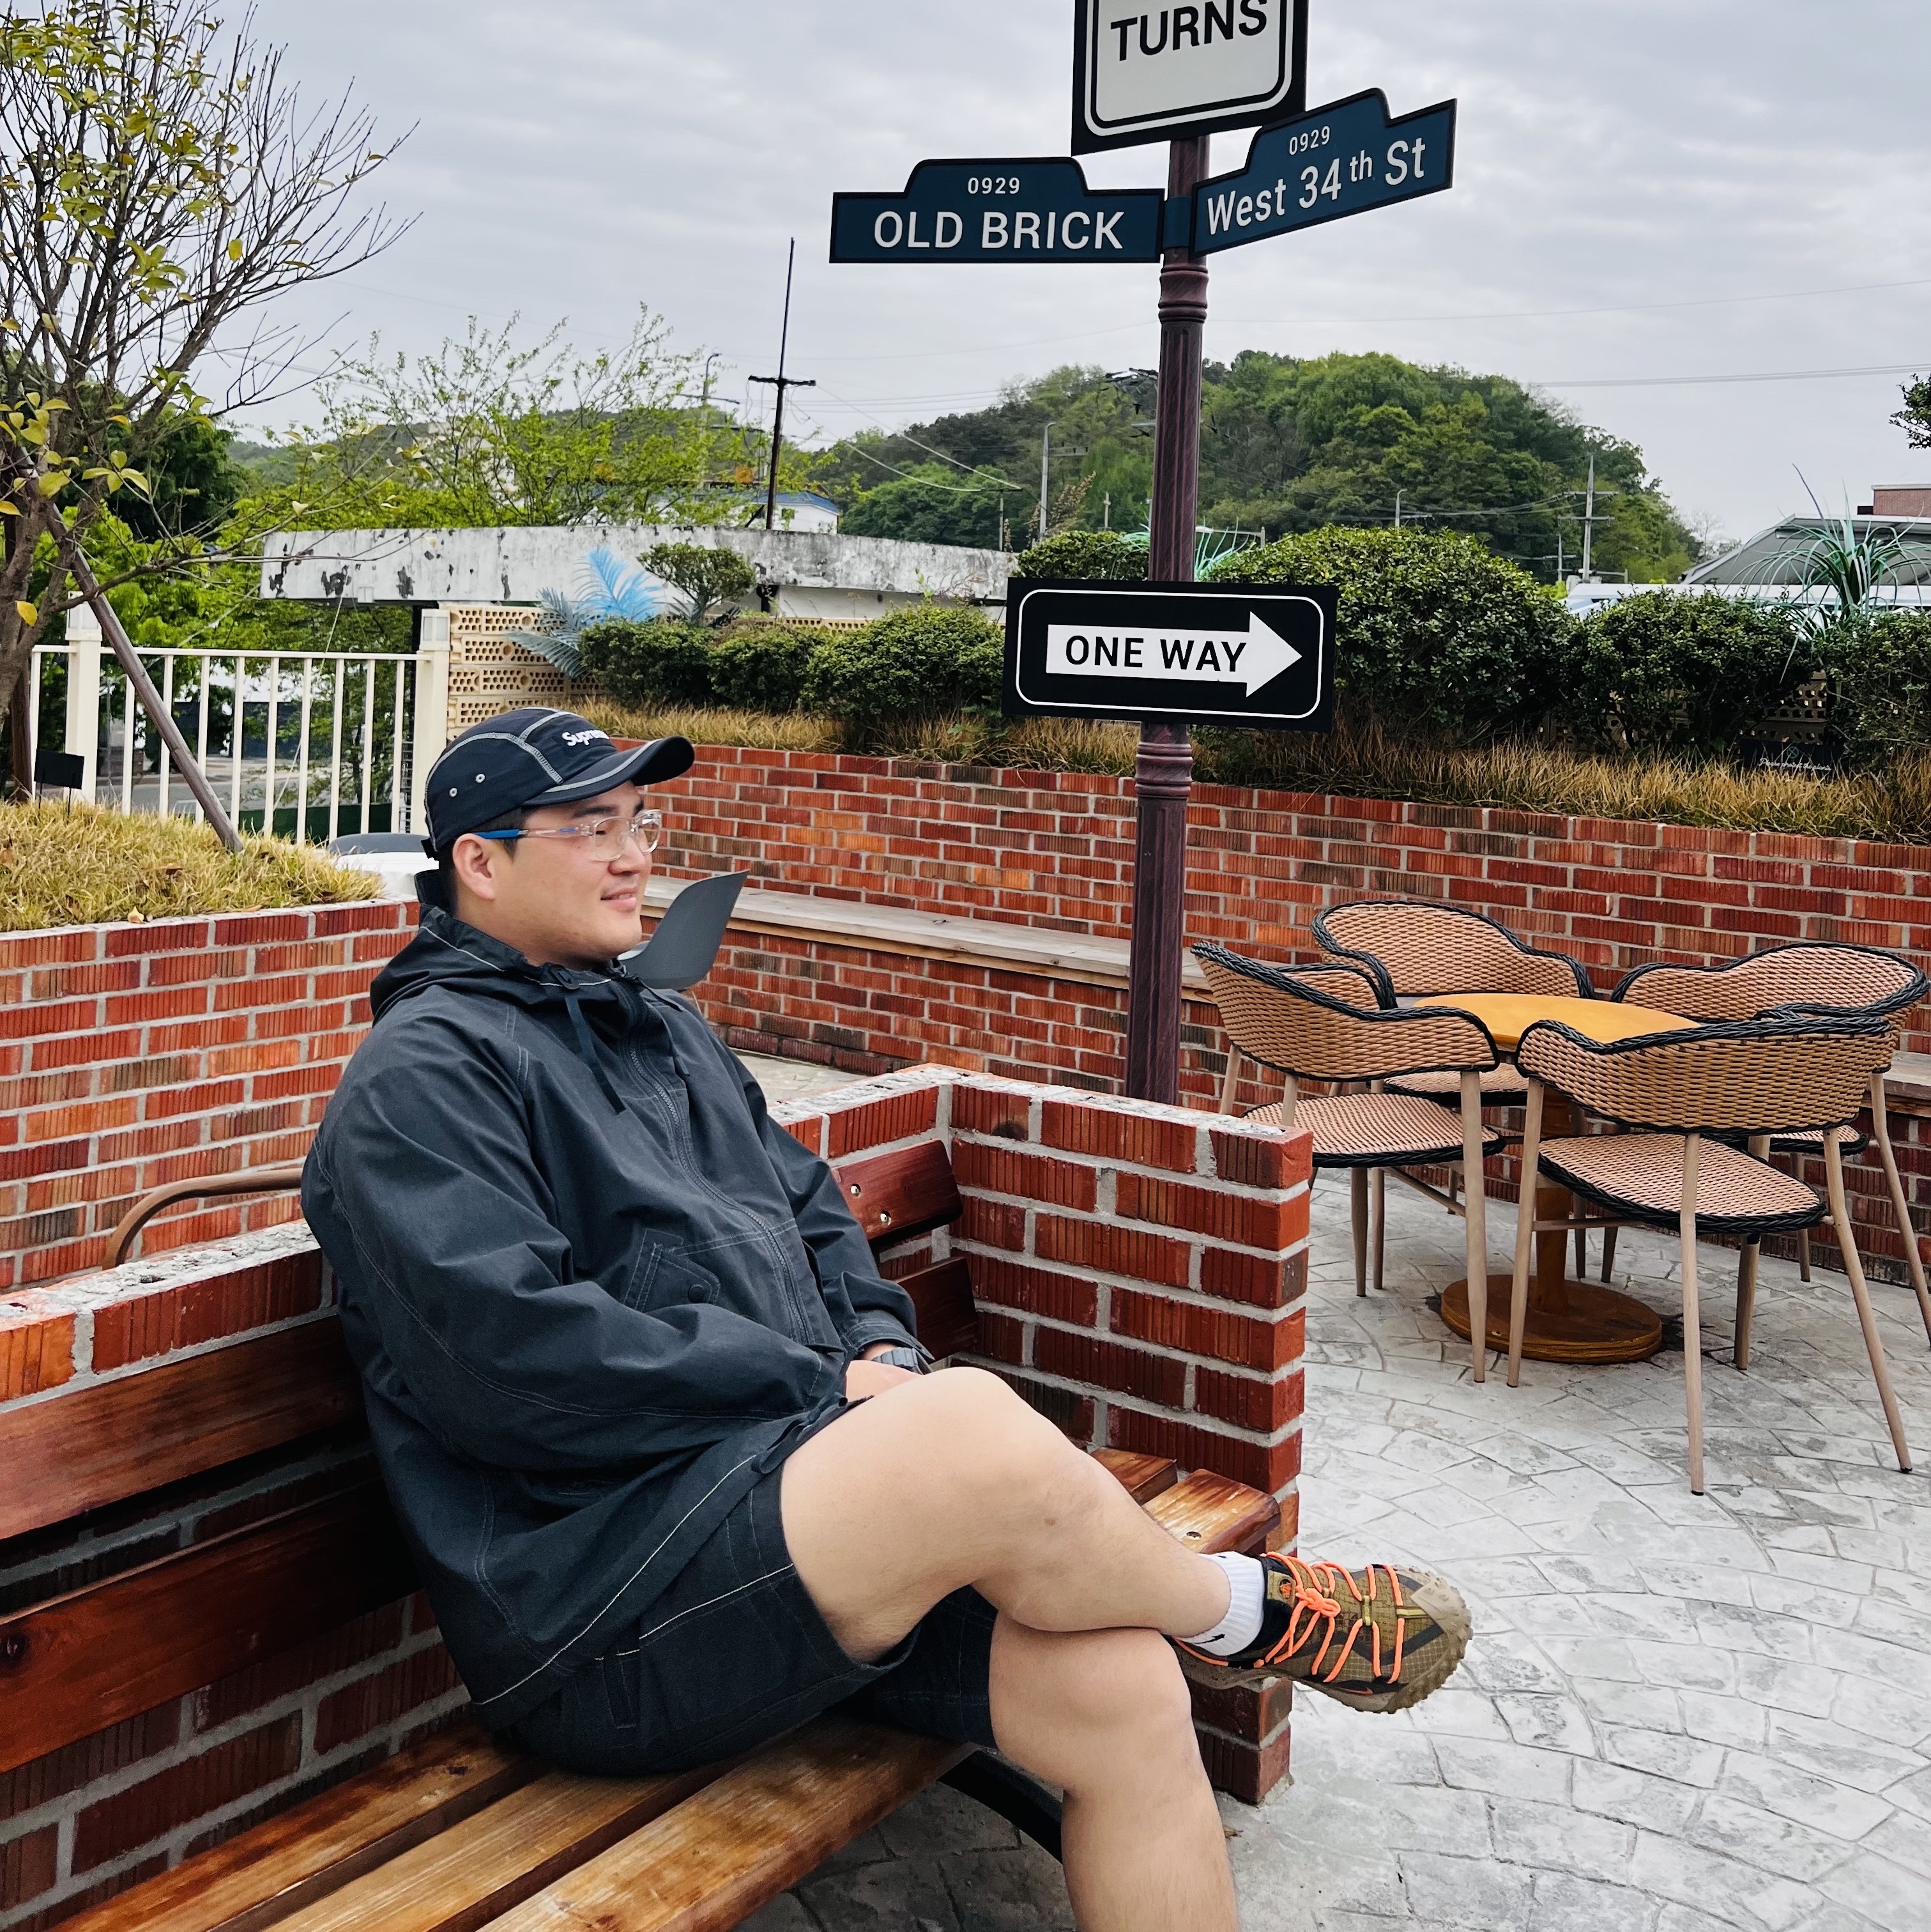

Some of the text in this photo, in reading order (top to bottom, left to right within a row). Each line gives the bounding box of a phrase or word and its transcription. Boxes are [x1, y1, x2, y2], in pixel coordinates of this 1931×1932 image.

[1110, 0, 1267, 61] TURNS
[1289, 126, 1330, 155] 0929
[968, 177, 1019, 194] 0929
[1207, 178, 1286, 235] West
[1385, 137, 1426, 185] St
[874, 211, 1124, 249] OLD BRICK
[1065, 635, 1247, 672] ONE WAY
[562, 730, 610, 746] Suprem
